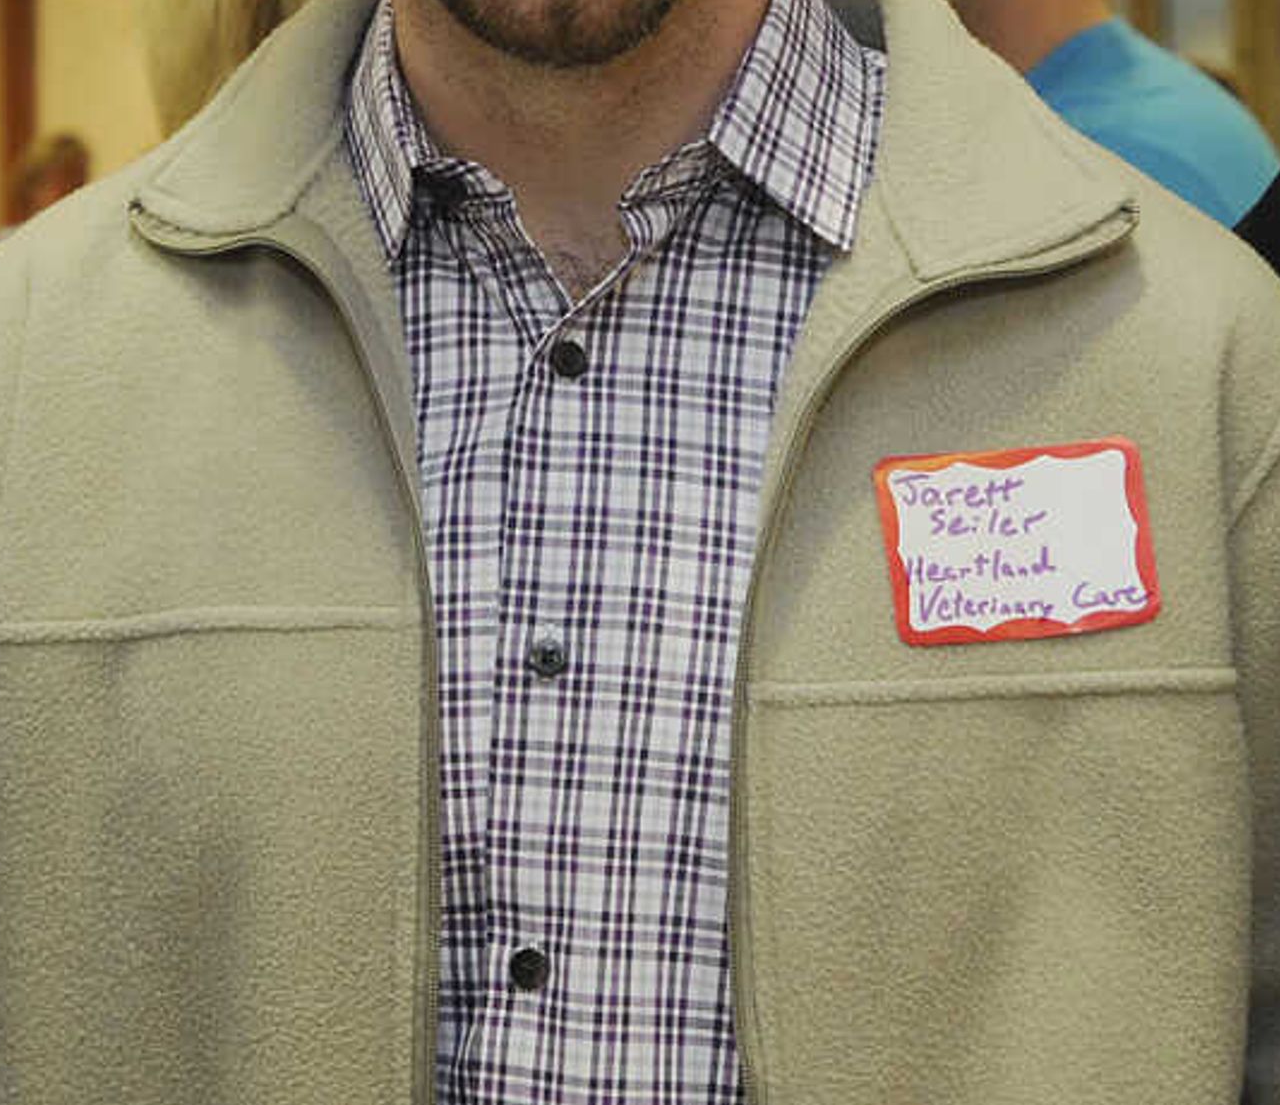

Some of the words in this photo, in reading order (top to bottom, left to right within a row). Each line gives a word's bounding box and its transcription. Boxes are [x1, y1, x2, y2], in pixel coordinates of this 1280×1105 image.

[893, 474, 1025, 507] Jarett
[906, 546, 1057, 585] Heartland
[918, 585, 1055, 624] Veterinary
[1072, 581, 1155, 608] Care
